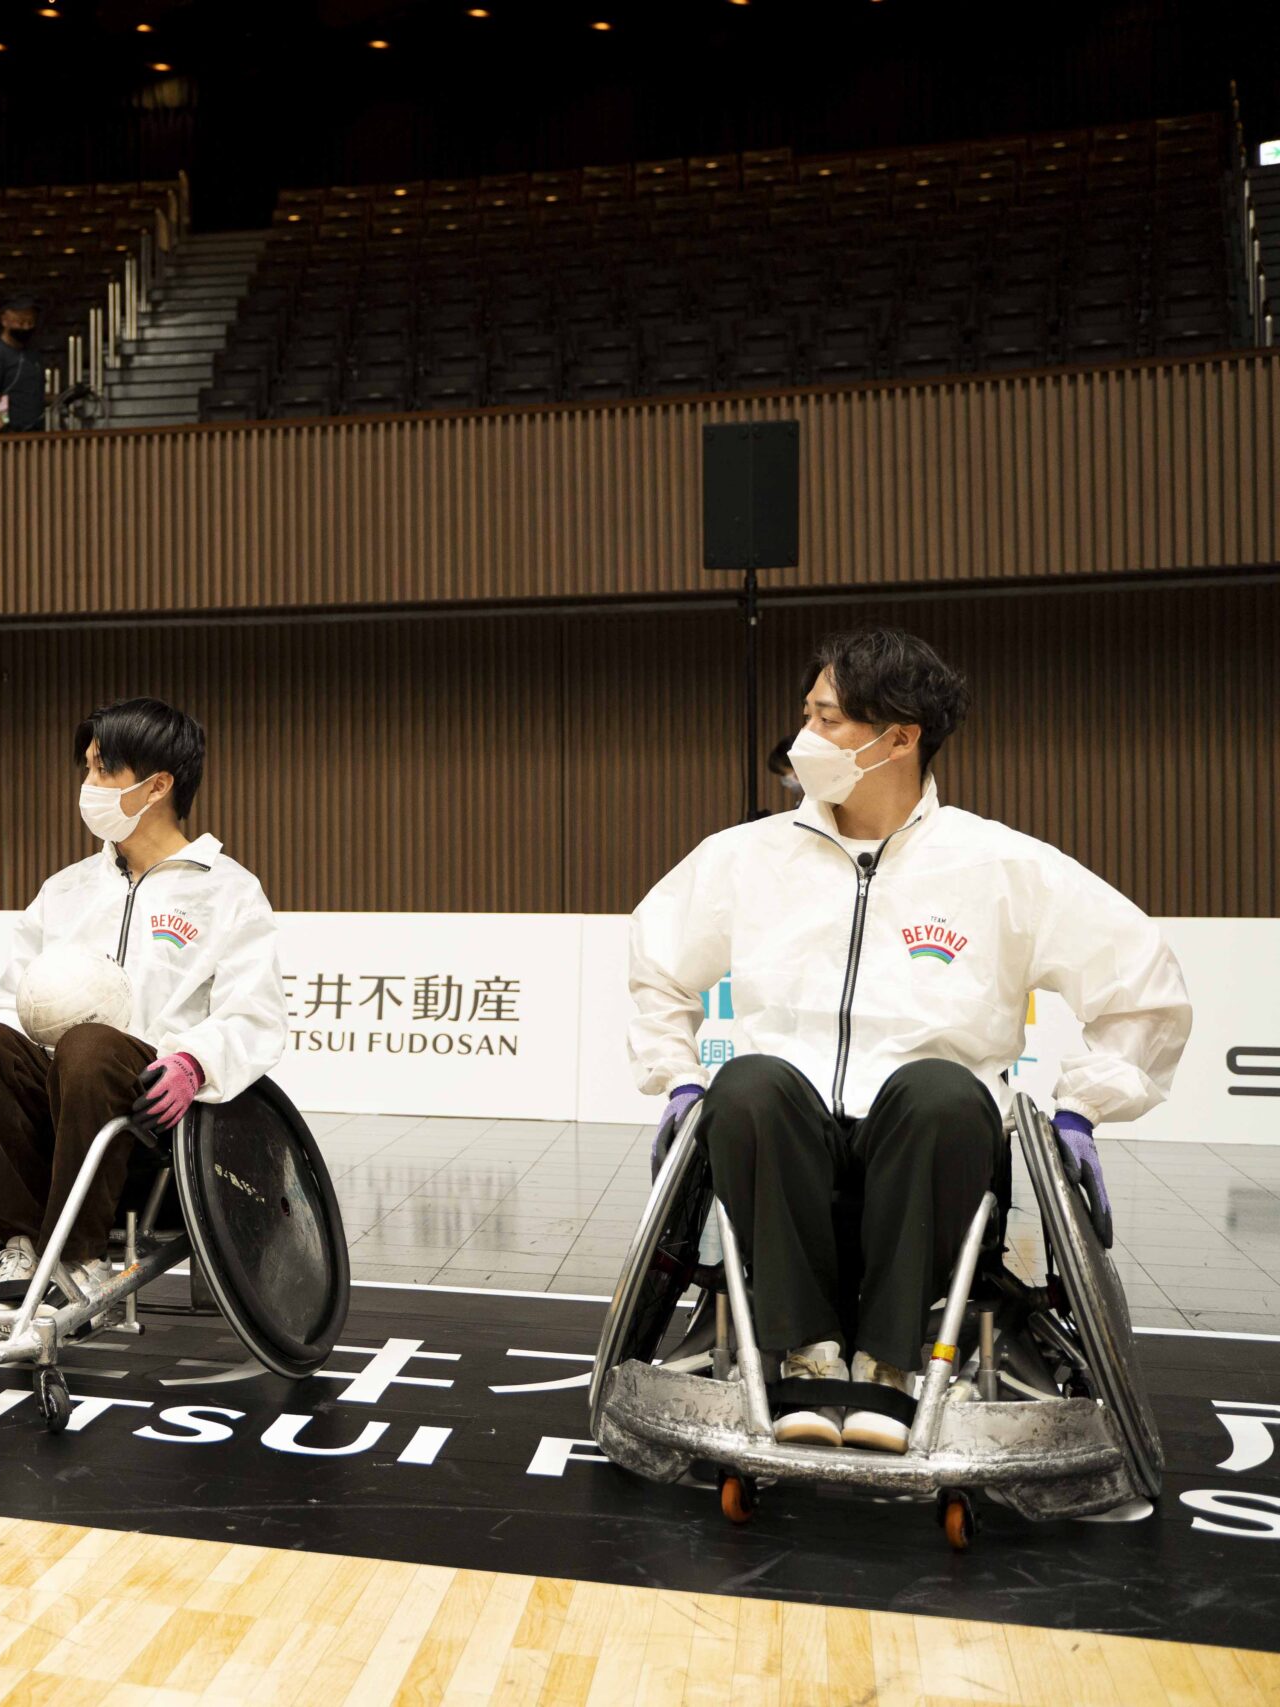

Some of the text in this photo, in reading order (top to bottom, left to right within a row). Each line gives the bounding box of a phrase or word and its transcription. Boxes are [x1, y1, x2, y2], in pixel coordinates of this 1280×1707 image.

[151, 914, 198, 940] BEYOND
[901, 924, 968, 952] BEYOND
[282, 1030, 518, 1056] TSUI FUDOSAN
